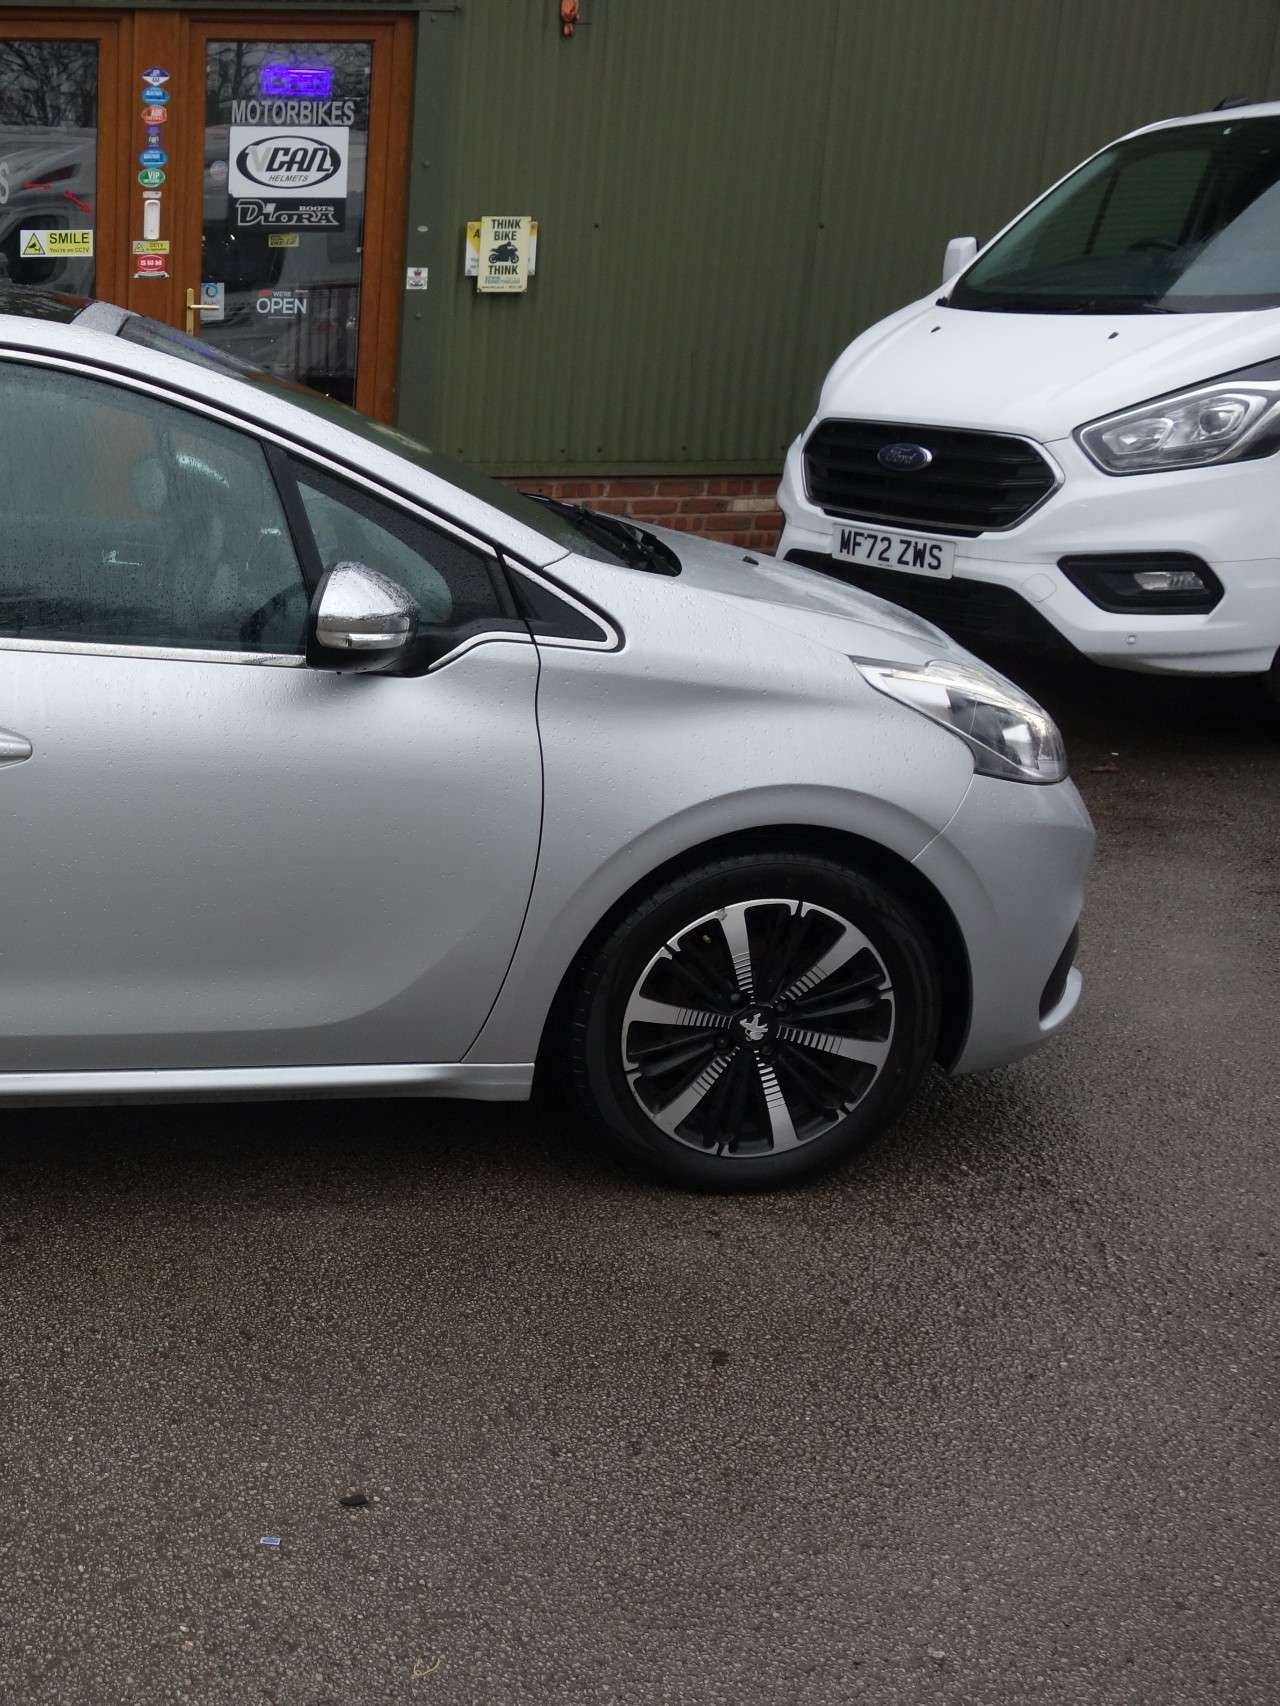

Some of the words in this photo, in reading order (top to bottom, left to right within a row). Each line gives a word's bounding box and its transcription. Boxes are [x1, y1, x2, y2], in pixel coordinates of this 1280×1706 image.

[231, 99, 356, 126] MOTORBIKES
[268, 174, 309, 183] HELMETS
[491, 219, 522, 230] THINK
[49, 232, 90, 245] SMILE
[493, 230, 518, 241] BIKE
[487, 264, 519, 276] THINK
[256, 298, 307, 314] OPEN
[839, 528, 892, 563] MF72
[896, 538, 943, 571] ZWS
